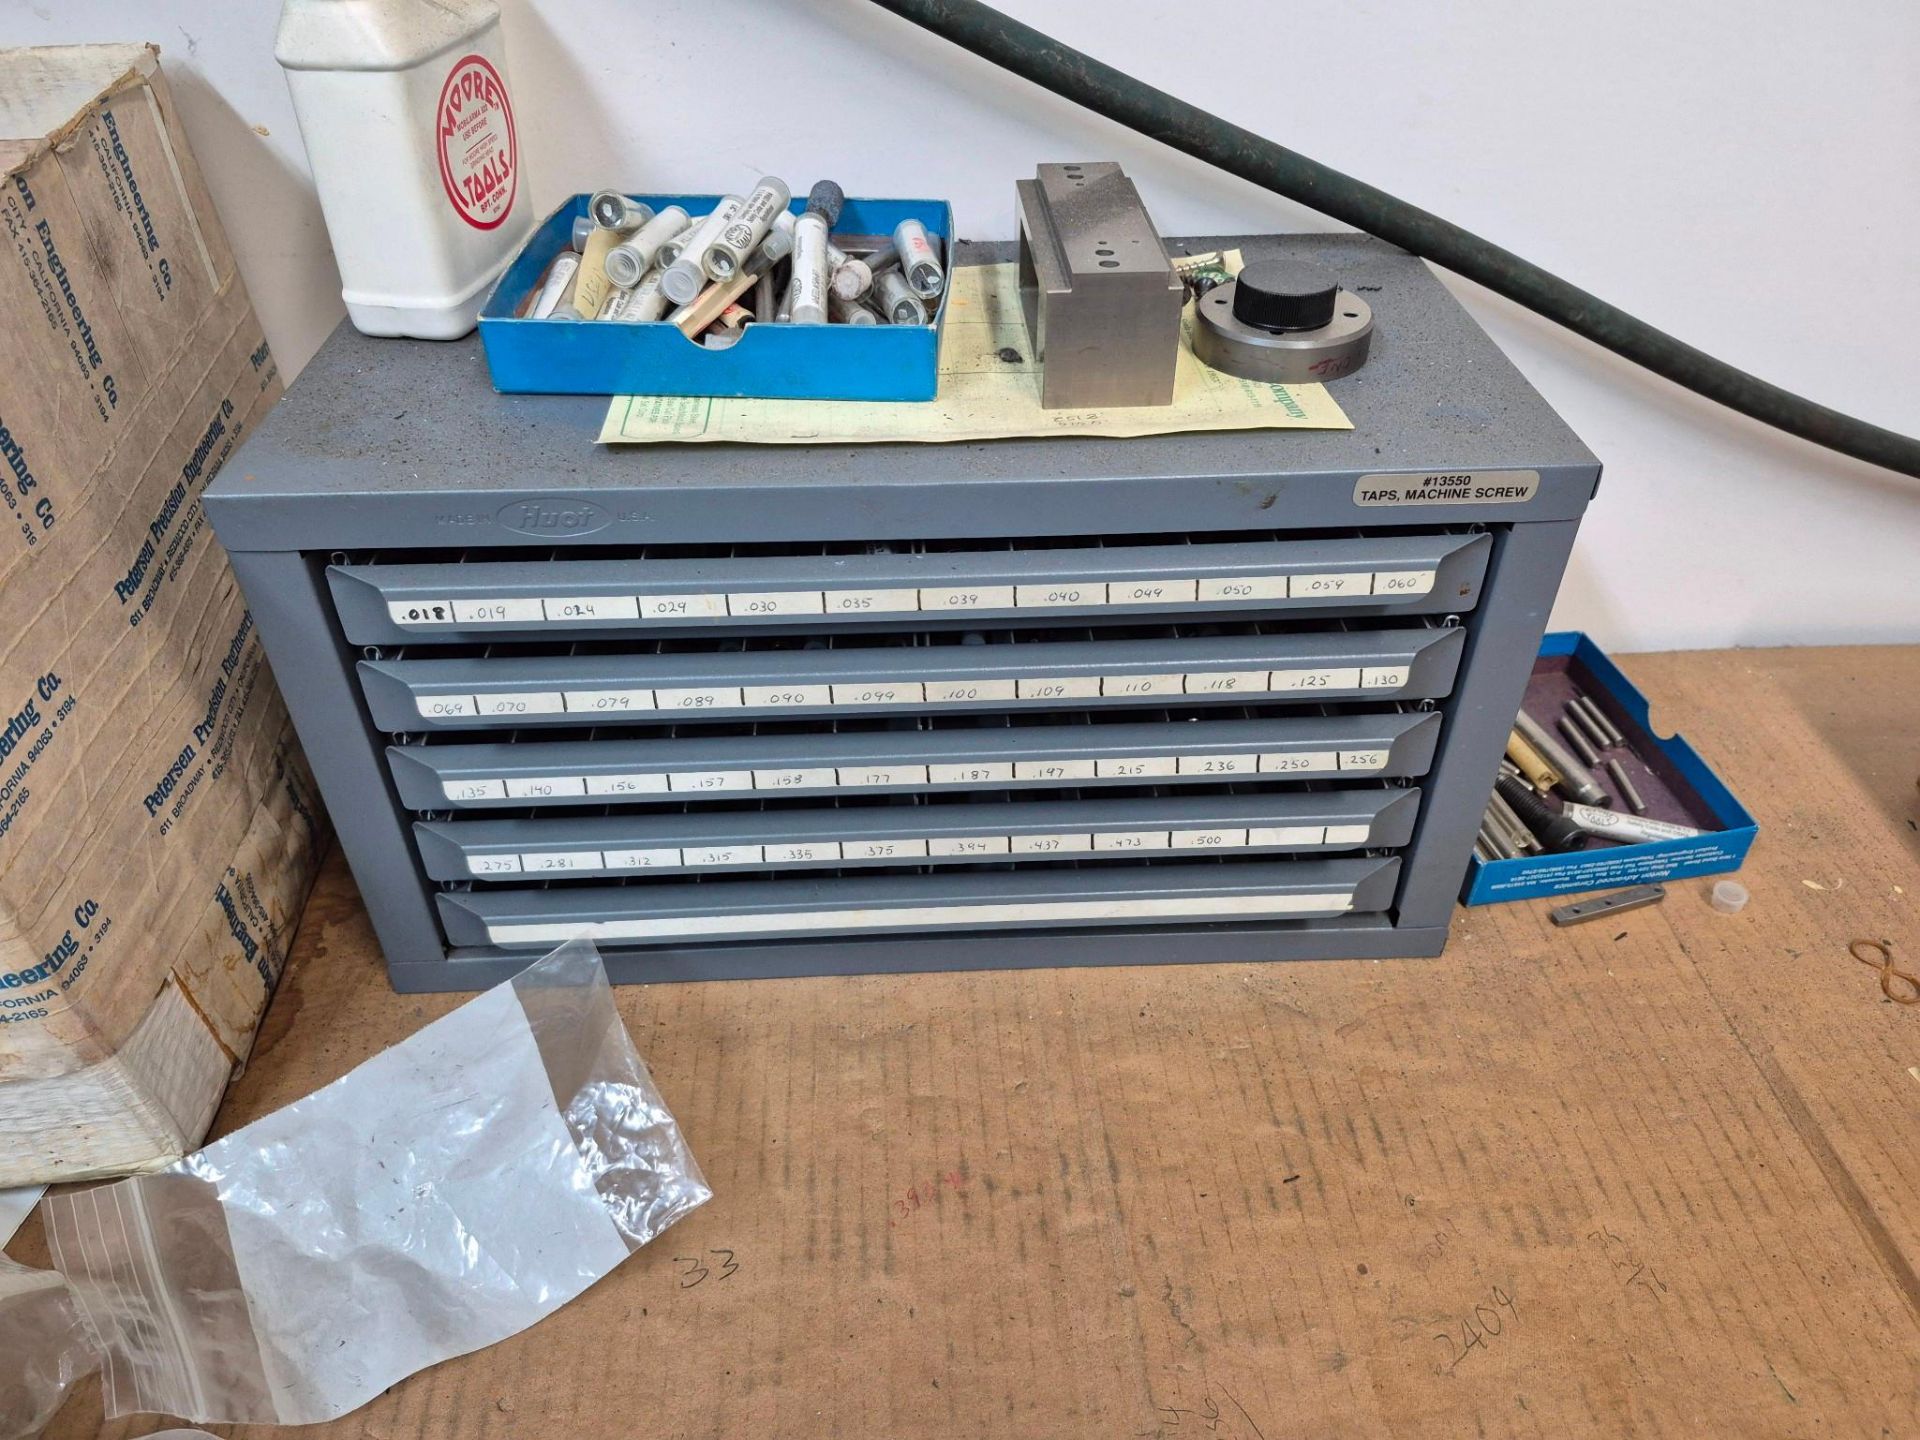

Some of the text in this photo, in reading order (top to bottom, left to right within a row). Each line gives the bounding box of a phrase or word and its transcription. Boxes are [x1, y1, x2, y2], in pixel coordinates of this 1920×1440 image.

[102, 110, 171, 291] Engineering Co.
[0, 208, 20, 240] FAX
[7, 195, 28, 230] CITY
[32, 250, 71, 338] CALIFORNIA
[14, 174, 119, 410] on Engineering Co.
[1269, 383, 1309, 420] ompany
[1361, 486, 1529, 502] TAPS, MACHINE SCREW
[1422, 475, 1472, 487] #13550
[113, 539, 156, 605] Petersen
[149, 483, 187, 546] Precision
[182, 419, 226, 488] Engineering
[519, 504, 596, 530] Huot
[130, 609, 145, 628] 611
[401, 606, 446, 621] .018
[469, 605, 506, 620] .019
[744, 600, 778, 613] .030
[837, 597, 873, 609] .035
[943, 594, 979, 606] .039
[1043, 591, 1080, 602] .040
[1216, 584, 1252, 596] .050
[1304, 579, 1345, 592] .059
[1382, 578, 1417, 590] .060
[37, 671, 62, 702] Co.
[492, 701, 527, 713] .070
[591, 696, 630, 709] .079
[677, 695, 715, 707] .089
[764, 693, 805, 704] .090
[943, 687, 978, 700] .100
[1030, 685, 1065, 698] .109
[1120, 681, 1152, 693] .110
[1203, 677, 1237, 690] .118
[1291, 674, 1331, 687] .125
[1367, 674, 1398, 686] .130
[0, 694, 76, 814] ORNIA 94063 3194
[143, 744, 197, 818] Petersen
[192, 676, 228, 748] Precision
[456, 785, 488, 799] .135
[522, 784, 552, 796] .140
[603, 781, 636, 793] .156
[691, 776, 725, 788] .157
[771, 774, 803, 786] .158
[860, 773, 891, 785] .177
[953, 769, 990, 781] .187
[1113, 764, 1146, 776] .215
[1198, 760, 1236, 772] .236
[1275, 758, 1310, 770] .250
[1345, 753, 1378, 766] .256
[159, 817, 174, 837] 611
[171, 766, 207, 819] BROADWAY
[479, 859, 513, 871] .275
[540, 857, 574, 869] .281
[624, 856, 652, 867] .312
[702, 852, 733, 863] .315
[864, 845, 894, 857] .375
[1029, 839, 1060, 850] .437
[1109, 837, 1142, 848] .473
[1191, 835, 1222, 846] .500
[74, 898, 99, 929] Co.
[0, 916, 112, 1010] ORNIA 94063 3194
[673, 1249, 740, 1289] 33
